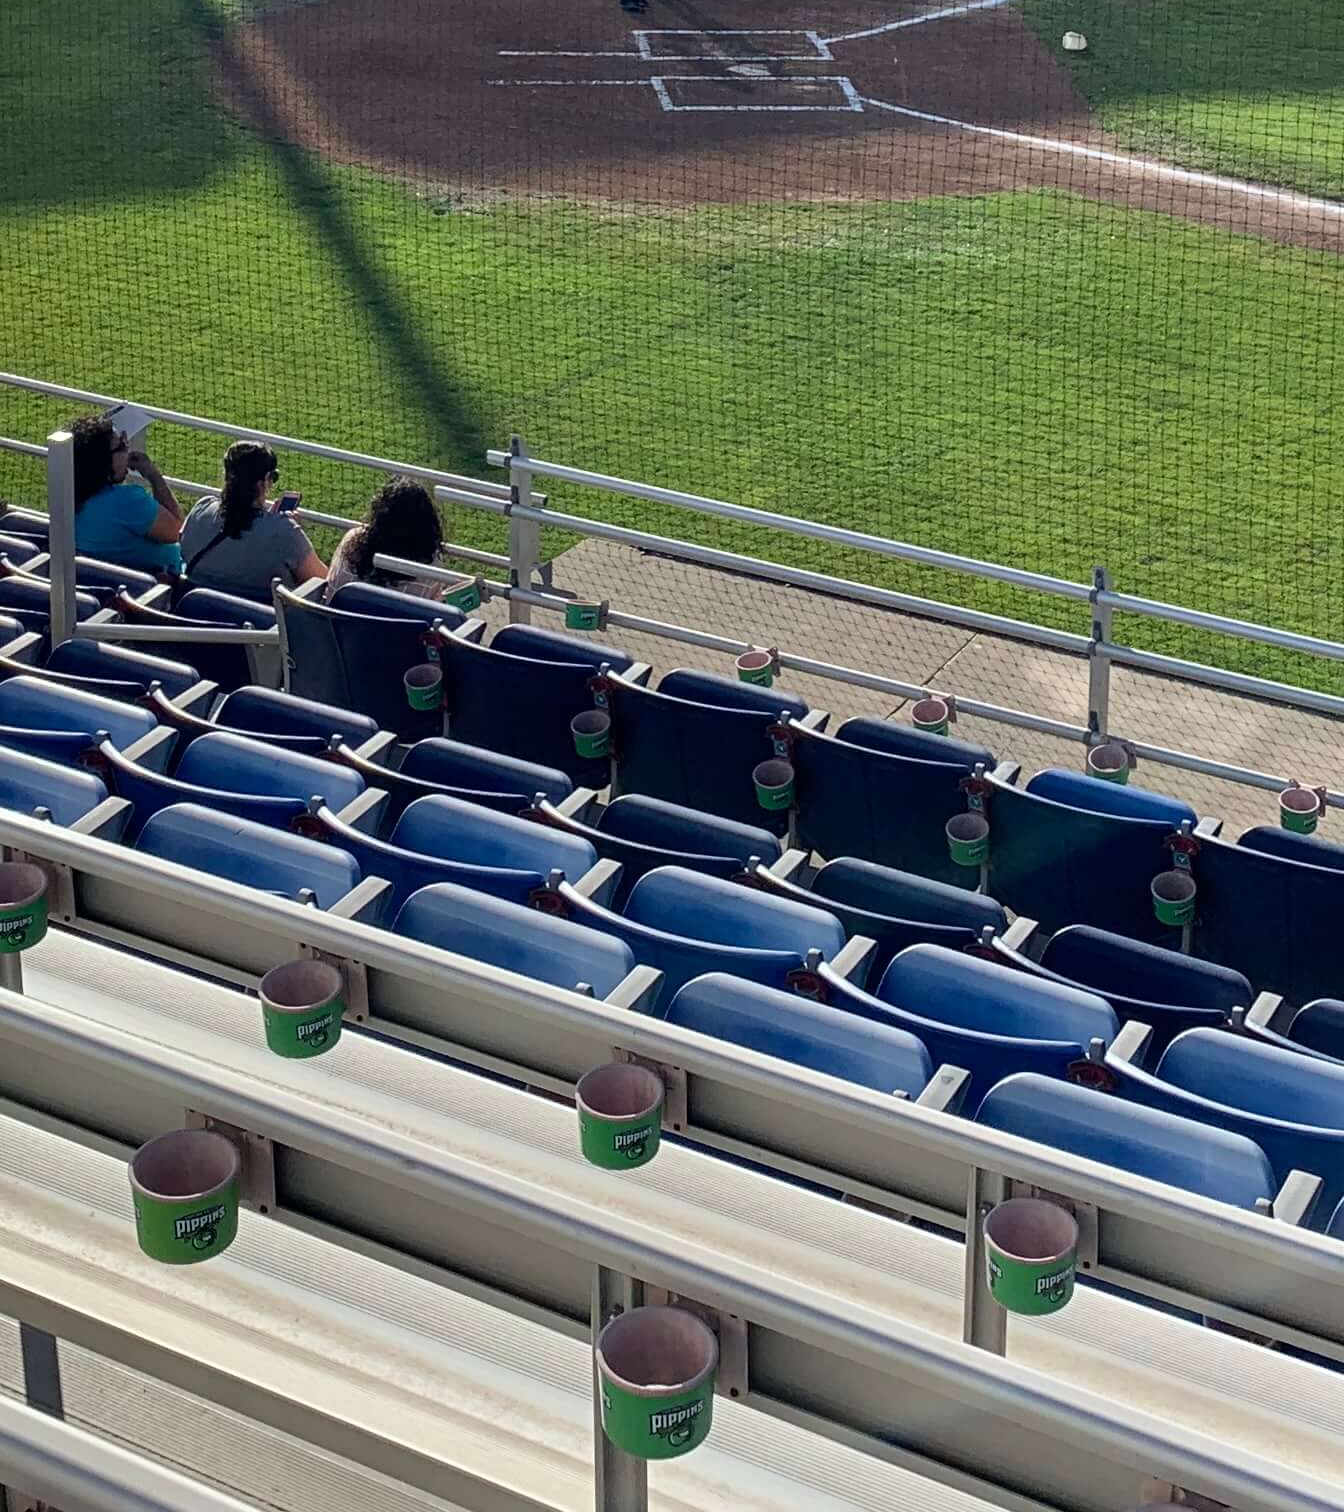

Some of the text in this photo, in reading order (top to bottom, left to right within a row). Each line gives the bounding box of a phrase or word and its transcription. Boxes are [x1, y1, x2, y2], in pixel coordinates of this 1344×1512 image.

[297, 1015, 334, 1039] PIPPINS
[614, 1125, 654, 1149] PIPPINS
[175, 1207, 225, 1238] PIPPINS
[651, 1400, 705, 1434] PIPPINS
